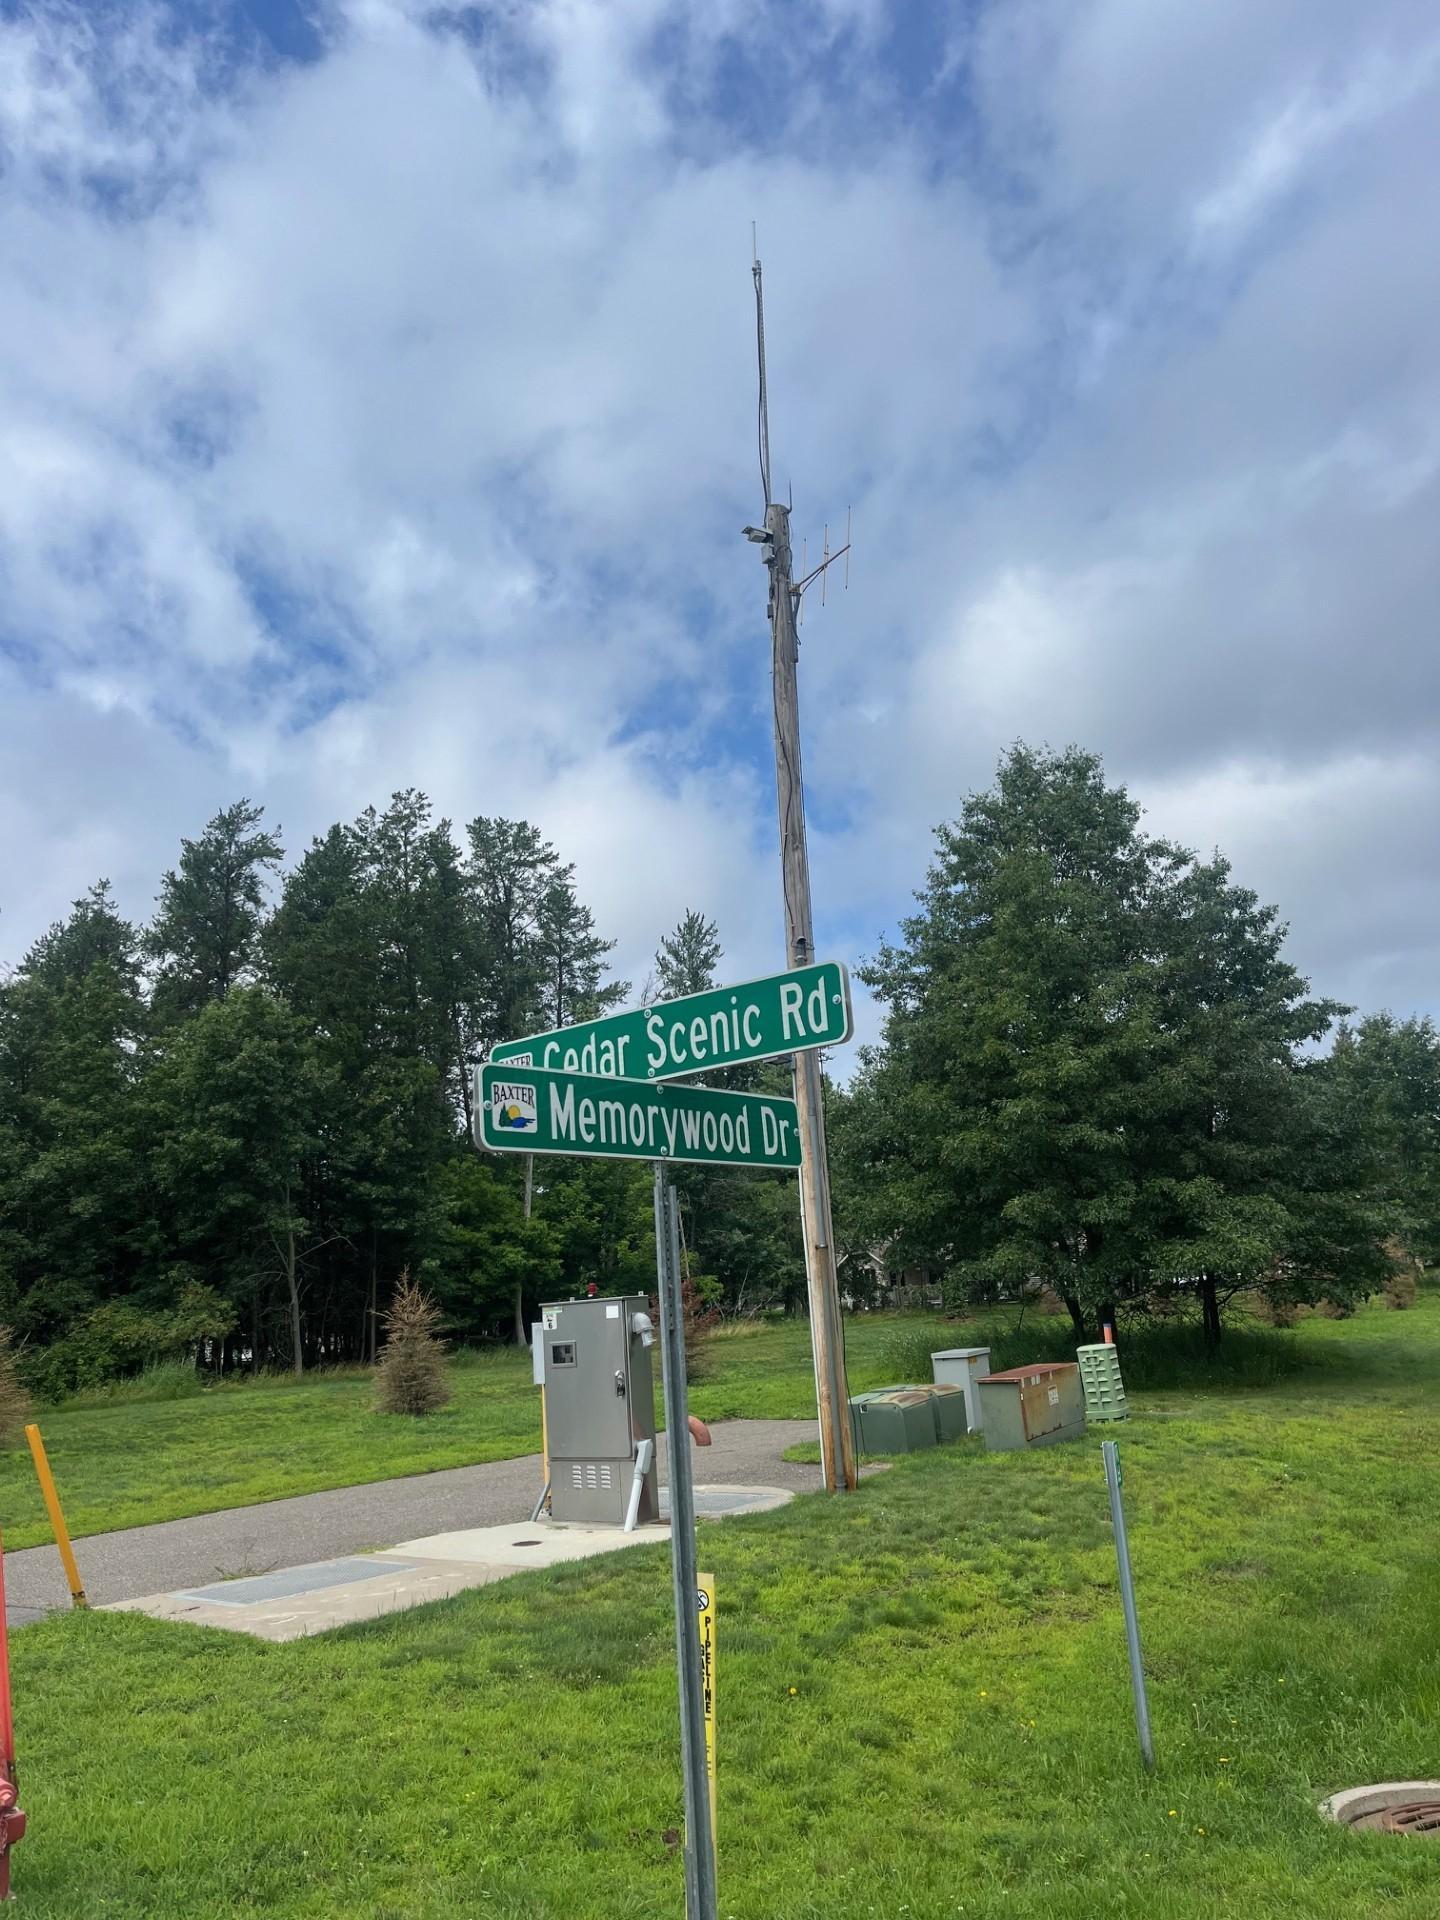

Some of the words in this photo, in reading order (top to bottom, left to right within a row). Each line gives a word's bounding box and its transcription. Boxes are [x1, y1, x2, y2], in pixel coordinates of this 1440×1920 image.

[544, 1031, 630, 1076] Cedar
[647, 996, 762, 1069] Scenic
[779, 975, 829, 1040] Rd
[493, 1084, 535, 1109] BAXTER
[549, 1082, 751, 1156] Memorywood
[761, 1105, 789, 1157] Dr
